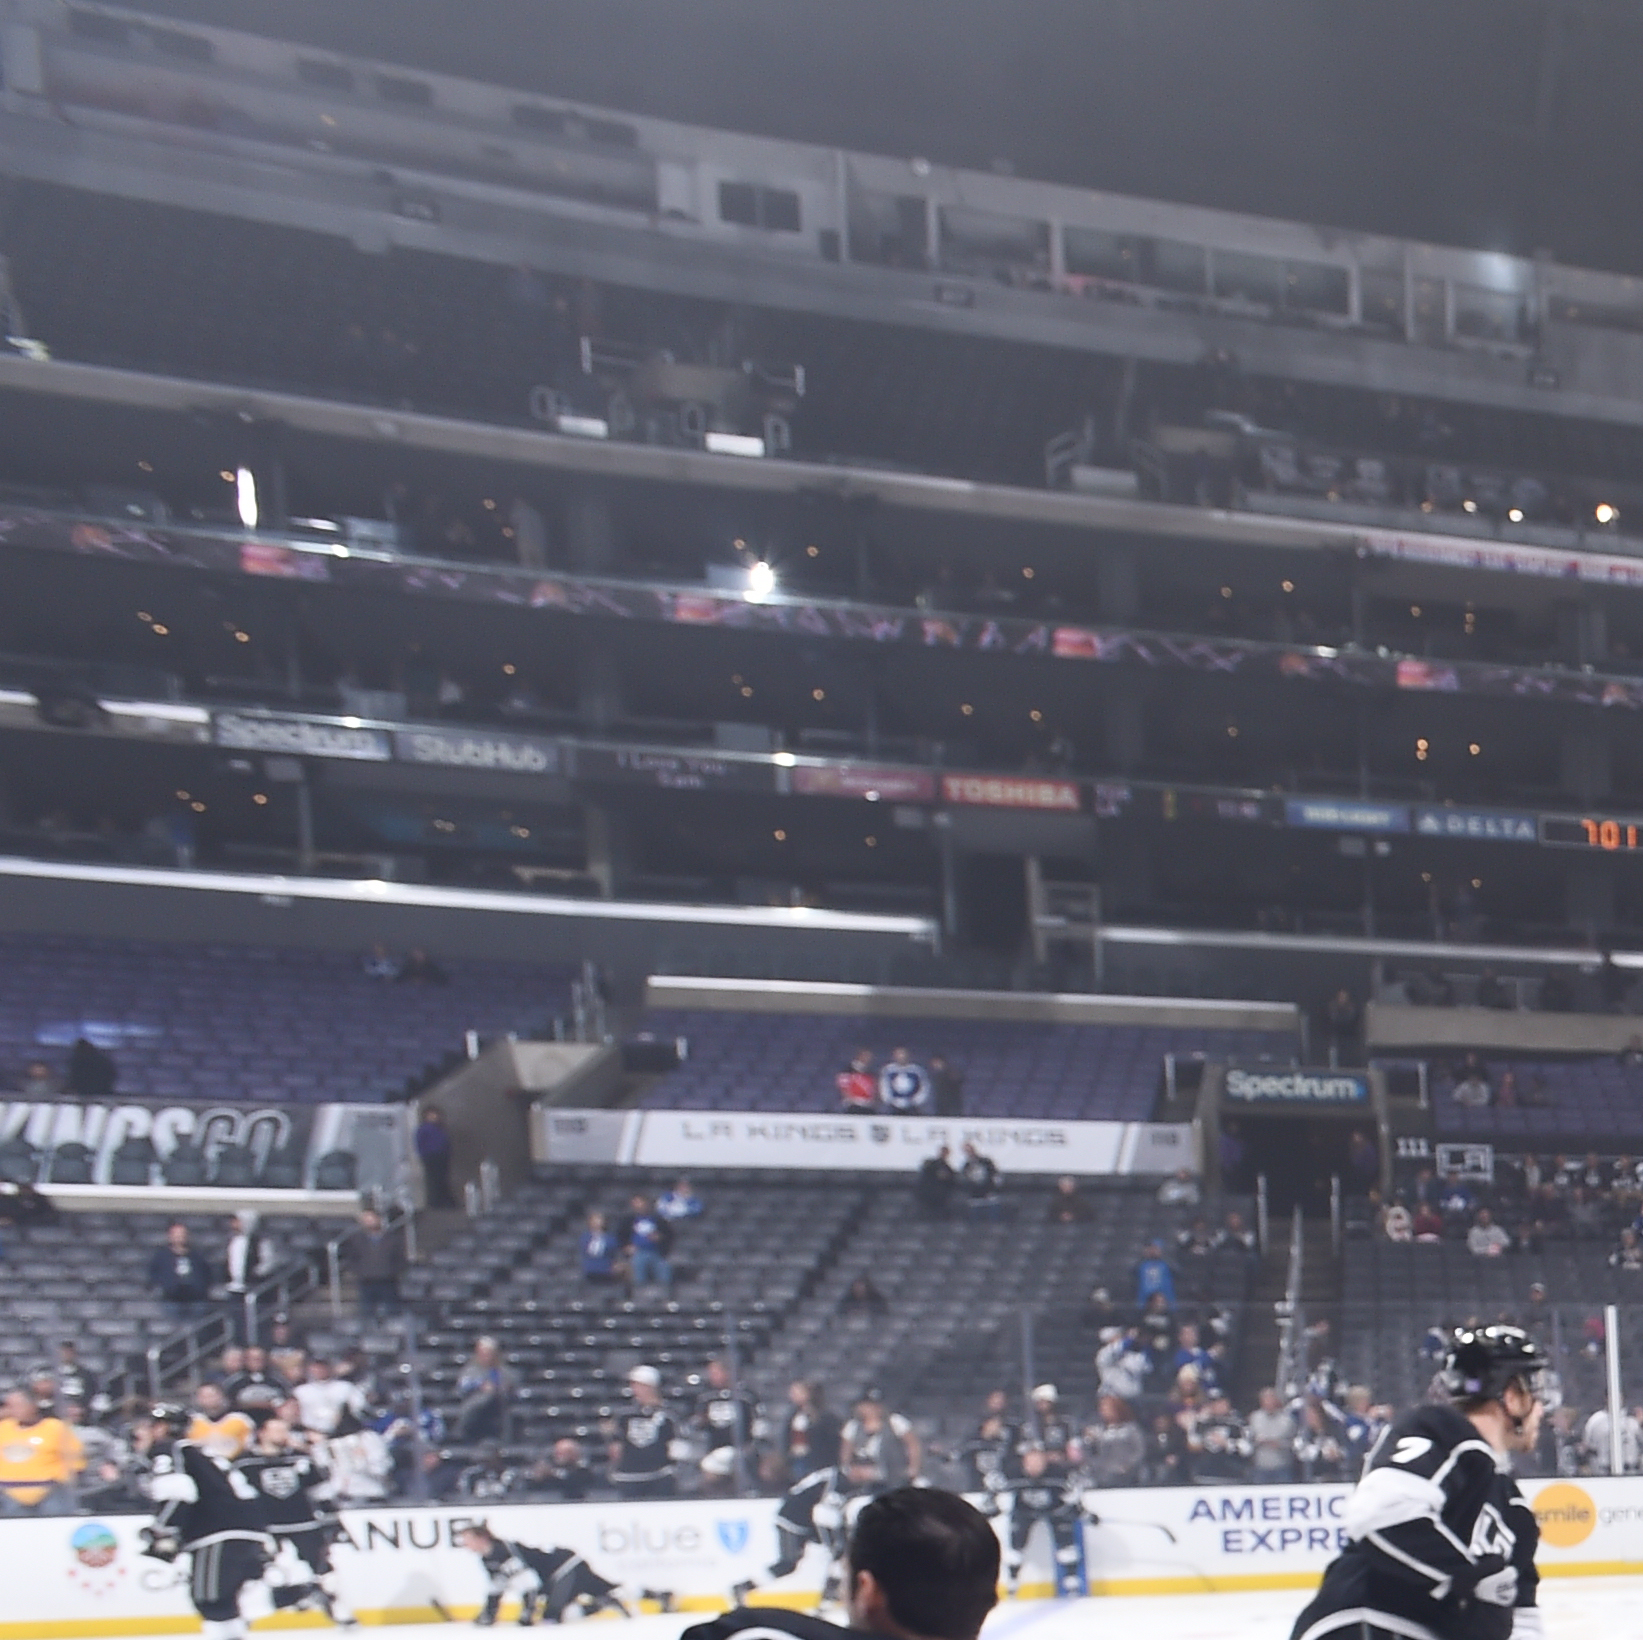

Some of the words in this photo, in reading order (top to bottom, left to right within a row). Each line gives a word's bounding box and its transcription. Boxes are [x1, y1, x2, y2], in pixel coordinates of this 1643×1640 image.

[412, 734, 548, 772] StubHub
[947, 779, 1079, 809] TOSHIBA
[1445, 813, 1537, 840] DELTA
[1225, 1069, 1362, 1101] Spectrum
[746, 1125, 857, 1143] KINGS
[1189, 1495, 1348, 1525] AMERIC
[599, 1519, 700, 1556] blue
[1221, 1527, 1347, 1554] EXPRE
